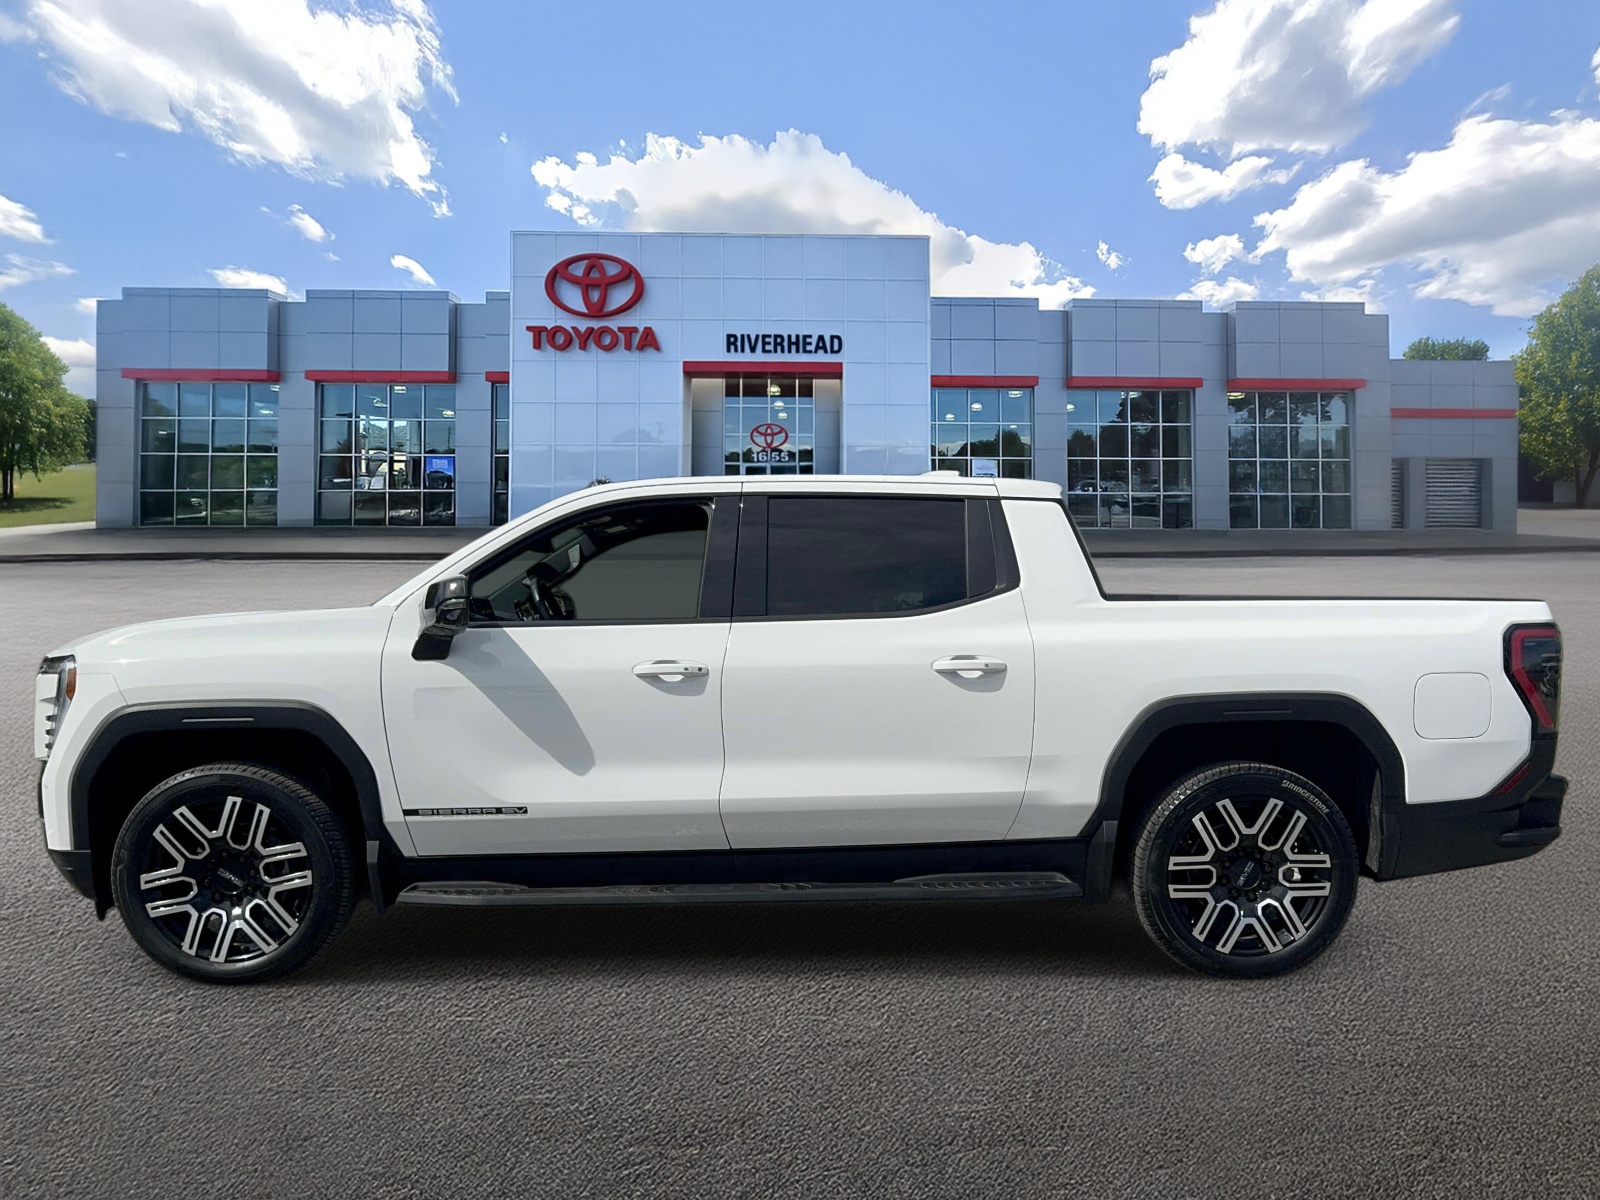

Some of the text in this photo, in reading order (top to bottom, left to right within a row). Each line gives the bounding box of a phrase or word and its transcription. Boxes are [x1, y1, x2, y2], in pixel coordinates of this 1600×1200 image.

[526, 325, 661, 351] TOYOTA
[726, 333, 843, 354] RIVERHEAD
[751, 451, 789, 462] 1655
[1281, 780, 1330, 814] BRIDGESTONE
[502, 807, 527, 815] EV
